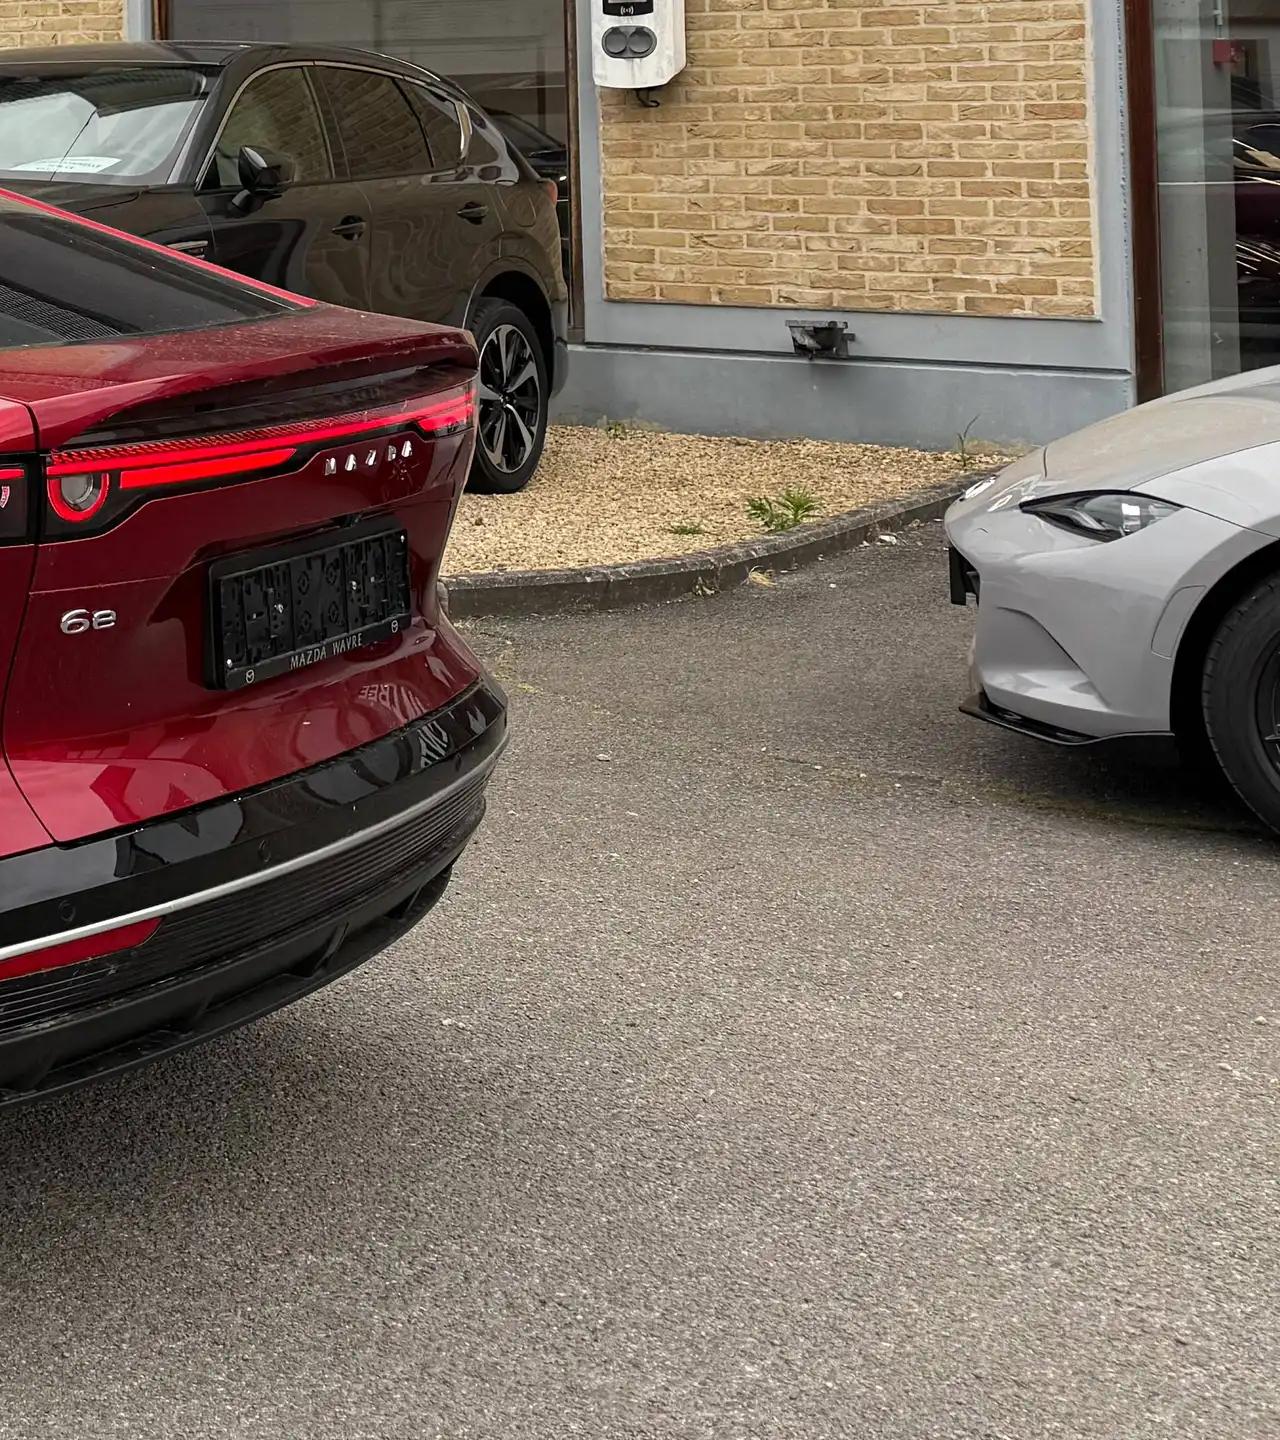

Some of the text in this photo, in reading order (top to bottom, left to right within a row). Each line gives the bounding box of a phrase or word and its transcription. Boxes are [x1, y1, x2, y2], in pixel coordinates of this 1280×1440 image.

[324, 439, 413, 477] MAZDA
[289, 632, 363, 671] MAZDA WAVRE
